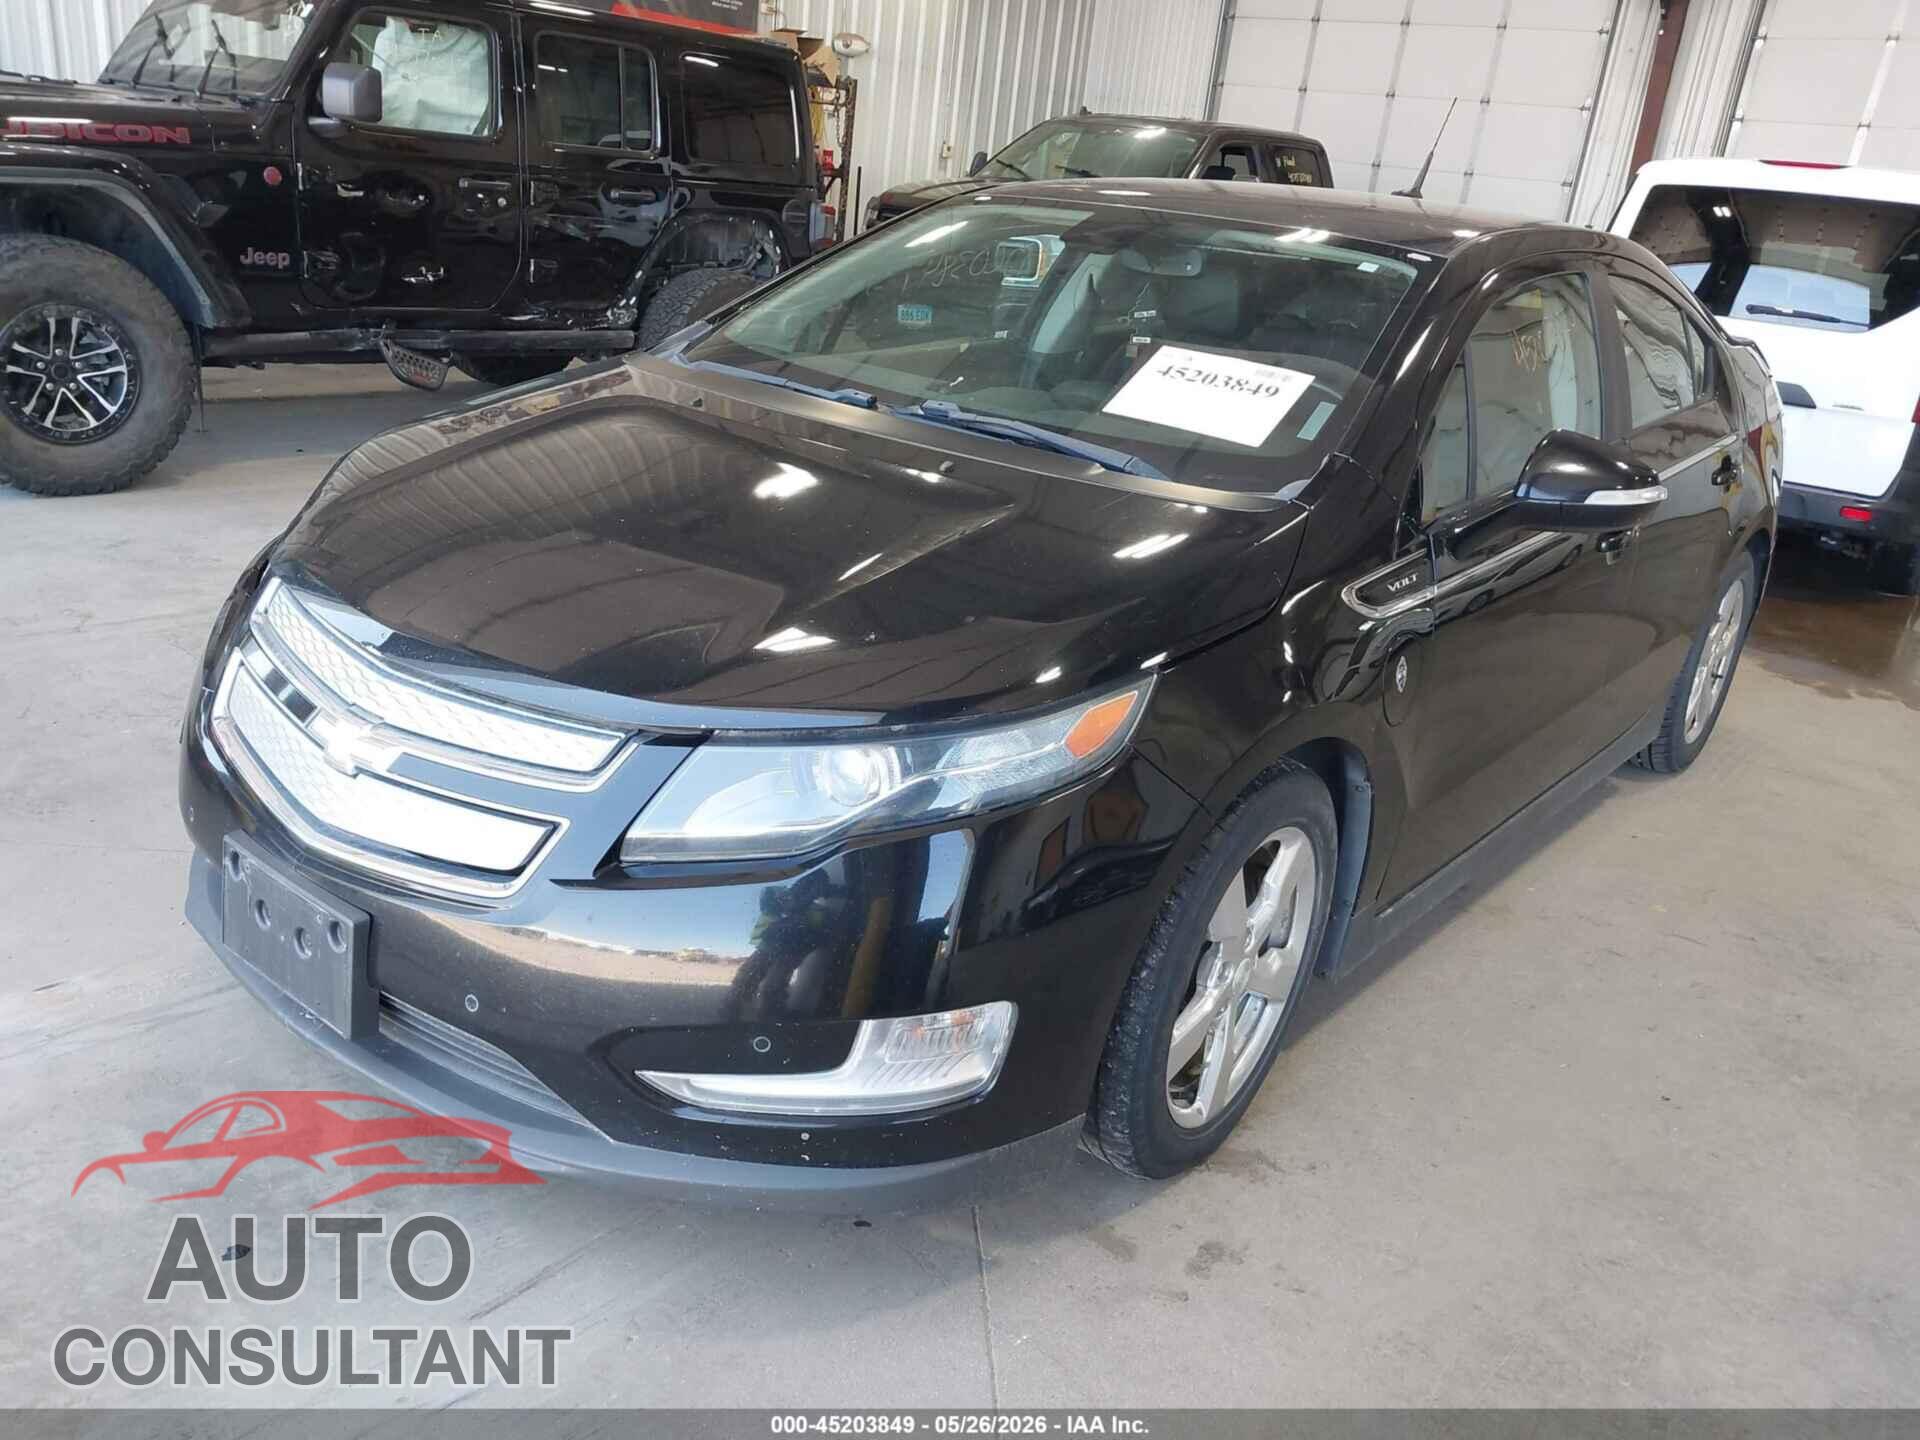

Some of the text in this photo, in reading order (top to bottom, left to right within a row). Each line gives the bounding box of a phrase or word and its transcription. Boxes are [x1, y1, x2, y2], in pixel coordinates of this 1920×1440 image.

[240, 246, 290, 269] Jeep
[1156, 364, 1281, 399] 45203849
[1386, 573, 1419, 592] VOLT
